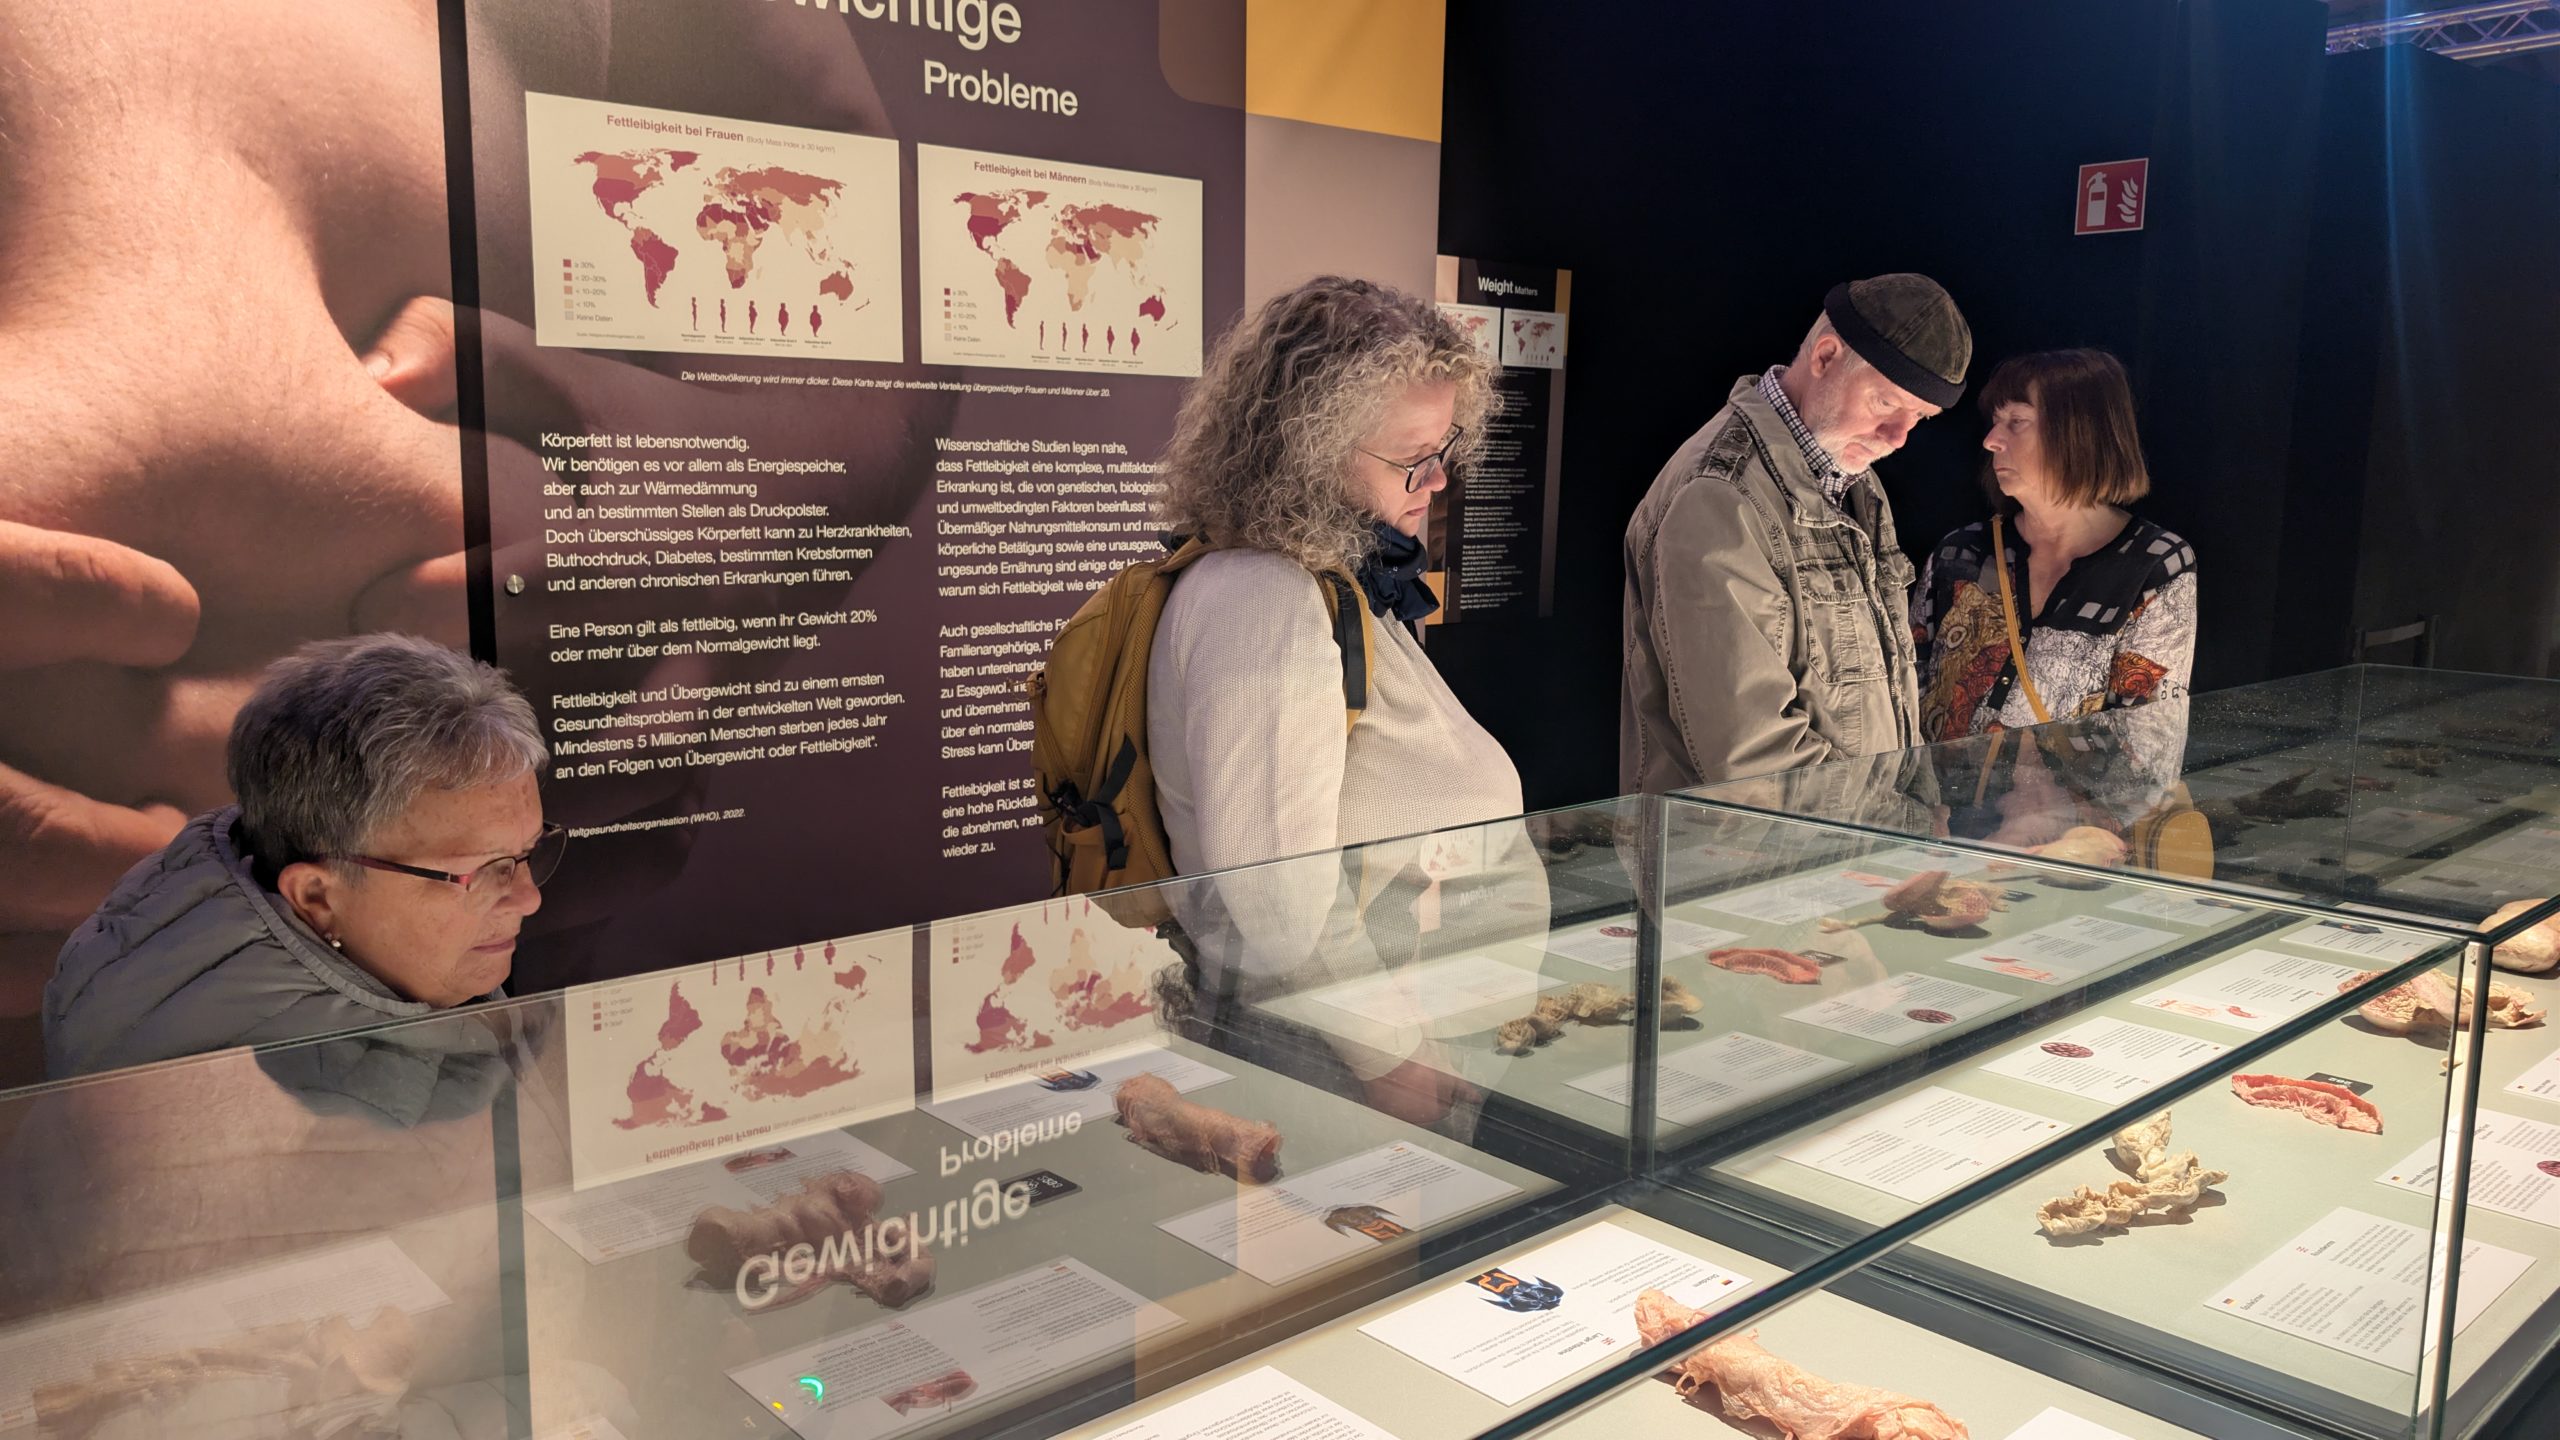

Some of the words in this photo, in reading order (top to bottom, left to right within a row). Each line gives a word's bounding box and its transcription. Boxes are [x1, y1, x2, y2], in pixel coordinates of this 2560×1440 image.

[924, 59, 1079, 117] Probleme
[606, 114, 683, 135] Fettleibigkeit
[685, 124, 702, 137] bei
[705, 127, 744, 142] Frauen
[974, 161, 1032, 179] Fettleibigkeit
[1034, 170, 1048, 180] bei
[1049, 170, 1087, 185] Männern
[1478, 275, 1514, 296] Weight
[1515, 286, 1538, 297] Matters
[681, 371, 696, 381] Die
[697, 371, 761, 385] Weltbevölkerung
[763, 374, 780, 384] wird
[781, 375, 804, 385] immer
[806, 376, 830, 386] dicker.
[832, 377, 853, 387] Diese
[854, 378, 874, 388] Karte
[875, 379, 893, 390] zeigt
[893, 379, 905, 389] die
[905, 380, 938, 391] weltweite
[939, 381, 972, 393] Verteilung
[972, 382, 1024, 395] übergewichtiger
[1025, 384, 1047, 394] Frauen
[1047, 386, 1060, 395] und
[1061, 385, 1085, 396] Männer
[1086, 386, 1100, 397] über
[1101, 388, 1110, 397] 20.
[541, 432, 612, 450] Körperfett
[616, 434, 632, 448] ist
[636, 434, 750, 452] lebensnotwendig.
[935, 437, 1030, 453] Wissenschaftliche
[1032, 439, 1071, 453] Studien
[1072, 441, 1099, 456] legen
[1101, 442, 1128, 455] nahe,
[542, 456, 567, 472] Wir
[571, 457, 639, 475] benötigen
[643, 460, 660, 472] es
[663, 460, 685, 472] vor
[688, 458, 722, 472] allem
[726, 458, 744, 472] als
[748, 458, 847, 475] Energiespeicher,
[936, 459, 963, 472] dass
[965, 460, 1029, 475] Fettleibigkeit
[1032, 461, 1053, 473] eine
[1055, 461, 1104, 476] komplexe,
[1107, 461, 1165, 474] multifaktori
[543, 481, 576, 496] aber
[580, 481, 615, 495] auch
[619, 484, 640, 495] zur
[643, 480, 757, 497] Wärmedämmung
[936, 480, 998, 495] Erkrankung
[1000, 481, 1015, 494] ist,
[1018, 481, 1033, 493] die
[1036, 483, 1055, 493] von
[1057, 481, 1118, 495] genetischen,
[544, 505, 572, 520] und
[576, 508, 595, 520] an
[599, 505, 678, 519] bestimmten
[681, 503, 725, 518] Stellen
[728, 503, 746, 517] als
[750, 503, 829, 519] Druckpolster.
[937, 501, 959, 513] und
[961, 500, 1049, 516] umweltbedingten
[1051, 500, 1095, 513] Faktoren
[1096, 500, 1146, 513] beeinflusst
[546, 529, 584, 544] Doch
[588, 528, 694, 544] überschüssiges
[697, 526, 761, 543] Körperfett
[764, 526, 795, 539] kann
[798, 528, 813, 538] zu
[816, 524, 912, 539] Herzkrankheiten,
[547, 552, 651, 568] Bluthochdruck,
[655, 550, 716, 565] Diabetes,
[720, 550, 793, 563] bestimmten
[797, 546, 873, 561] Krebsformen
[548, 577, 576, 591] und
[579, 575, 636, 590] anderen
[640, 573, 720, 588] chronischen
[723, 570, 809, 586] Erkrankungen
[812, 569, 853, 582] führen.
[550, 624, 580, 639] Eine
[584, 622, 633, 637] Person
[636, 620, 656, 638] gilt
[659, 619, 679, 633] als
[682, 616, 738, 633] fettleibig,
[742, 616, 776, 629] wenn
[780, 613, 795, 627] ihr
[798, 611, 847, 626] Gewicht
[850, 609, 877, 623] 20%
[551, 647, 584, 662] oder
[587, 645, 624, 660] mehr
[627, 644, 658, 658] über
[662, 642, 692, 656] dem
[696, 636, 790, 654] Normalgewicht
[793, 634, 821, 650] liegt.
[552, 690, 637, 709] Fettleibigkeit
[641, 687, 667, 702] und
[671, 682, 752, 700] Übergewicht
[755, 680, 781, 695] sind
[784, 681, 799, 692] zu
[802, 677, 838, 691] einem
[841, 673, 885, 688] ernsten
[554, 709, 694, 733] Gesundheitsproblem
[698, 708, 709, 720] in
[712, 705, 737, 720] der
[737, 700, 813, 717] entwickelten
[815, 696, 842, 711] Welt
[846, 692, 906, 711] geworden.
[554, 737, 634, 756] Mindestens
[637, 735, 647, 748] 5
[651, 731, 707, 747] Millionen
[710, 725, 776, 742] Menschen
[779, 720, 825, 735] sterben
[827, 717, 859, 734] jedes
[862, 714, 888, 728] Jahr
[556, 766, 574, 780] an
[578, 763, 605, 777] den
[608, 758, 654, 775] Folgen
[657, 757, 682, 769] von
[685, 747, 766, 767] Übergewicht
[768, 743, 797, 758] oder
[943, 842, 978, 858] wieder
[981, 841, 996, 853] zu.
[1585, 1332, 1604, 1345] Large
